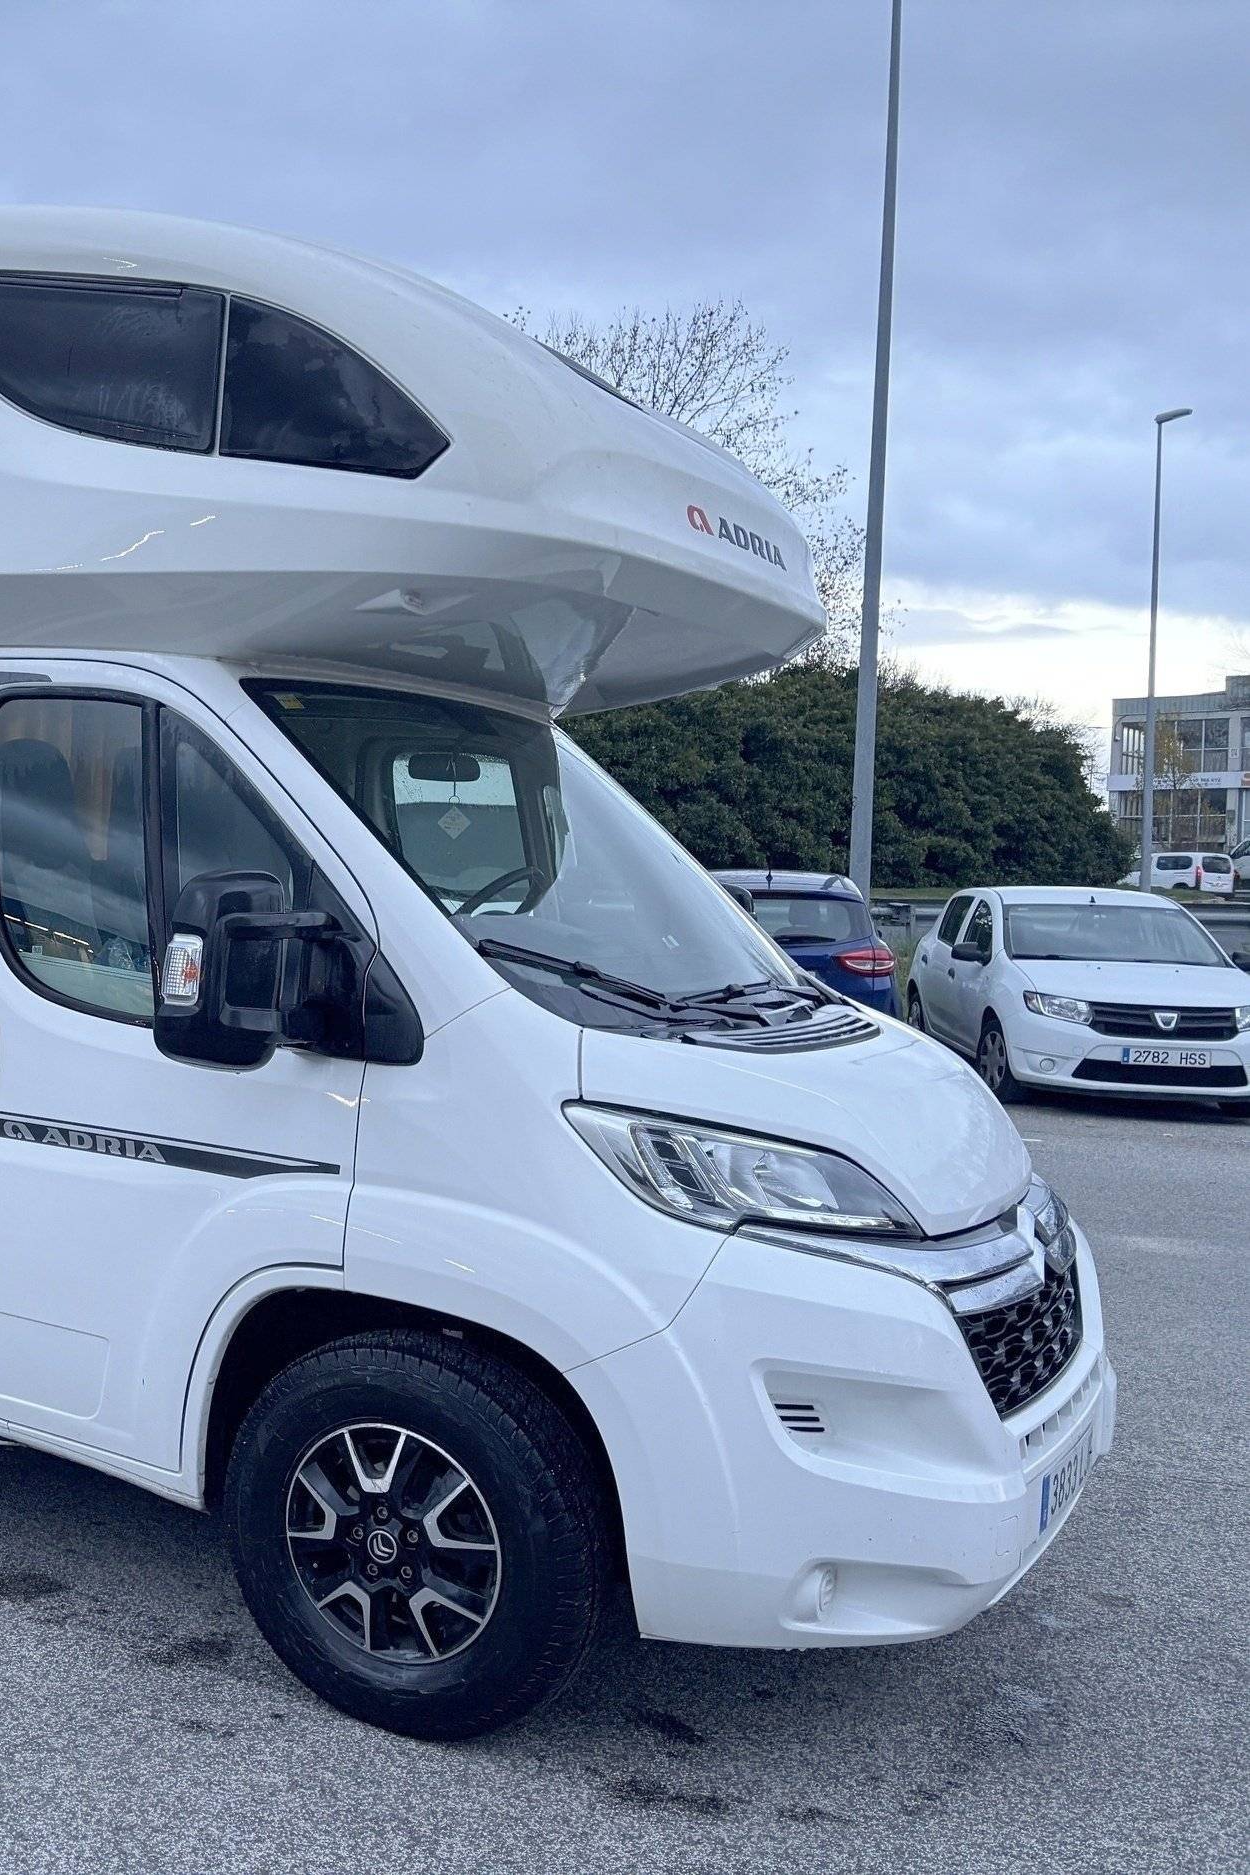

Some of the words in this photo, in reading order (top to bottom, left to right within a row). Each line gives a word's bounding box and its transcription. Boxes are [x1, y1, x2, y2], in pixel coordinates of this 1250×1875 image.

[718, 516, 788, 572] ADRIA
[1133, 1050, 1170, 1064] 2782
[1179, 1052, 1207, 1066] HSS
[41, 1127, 167, 1163] ADRIA
